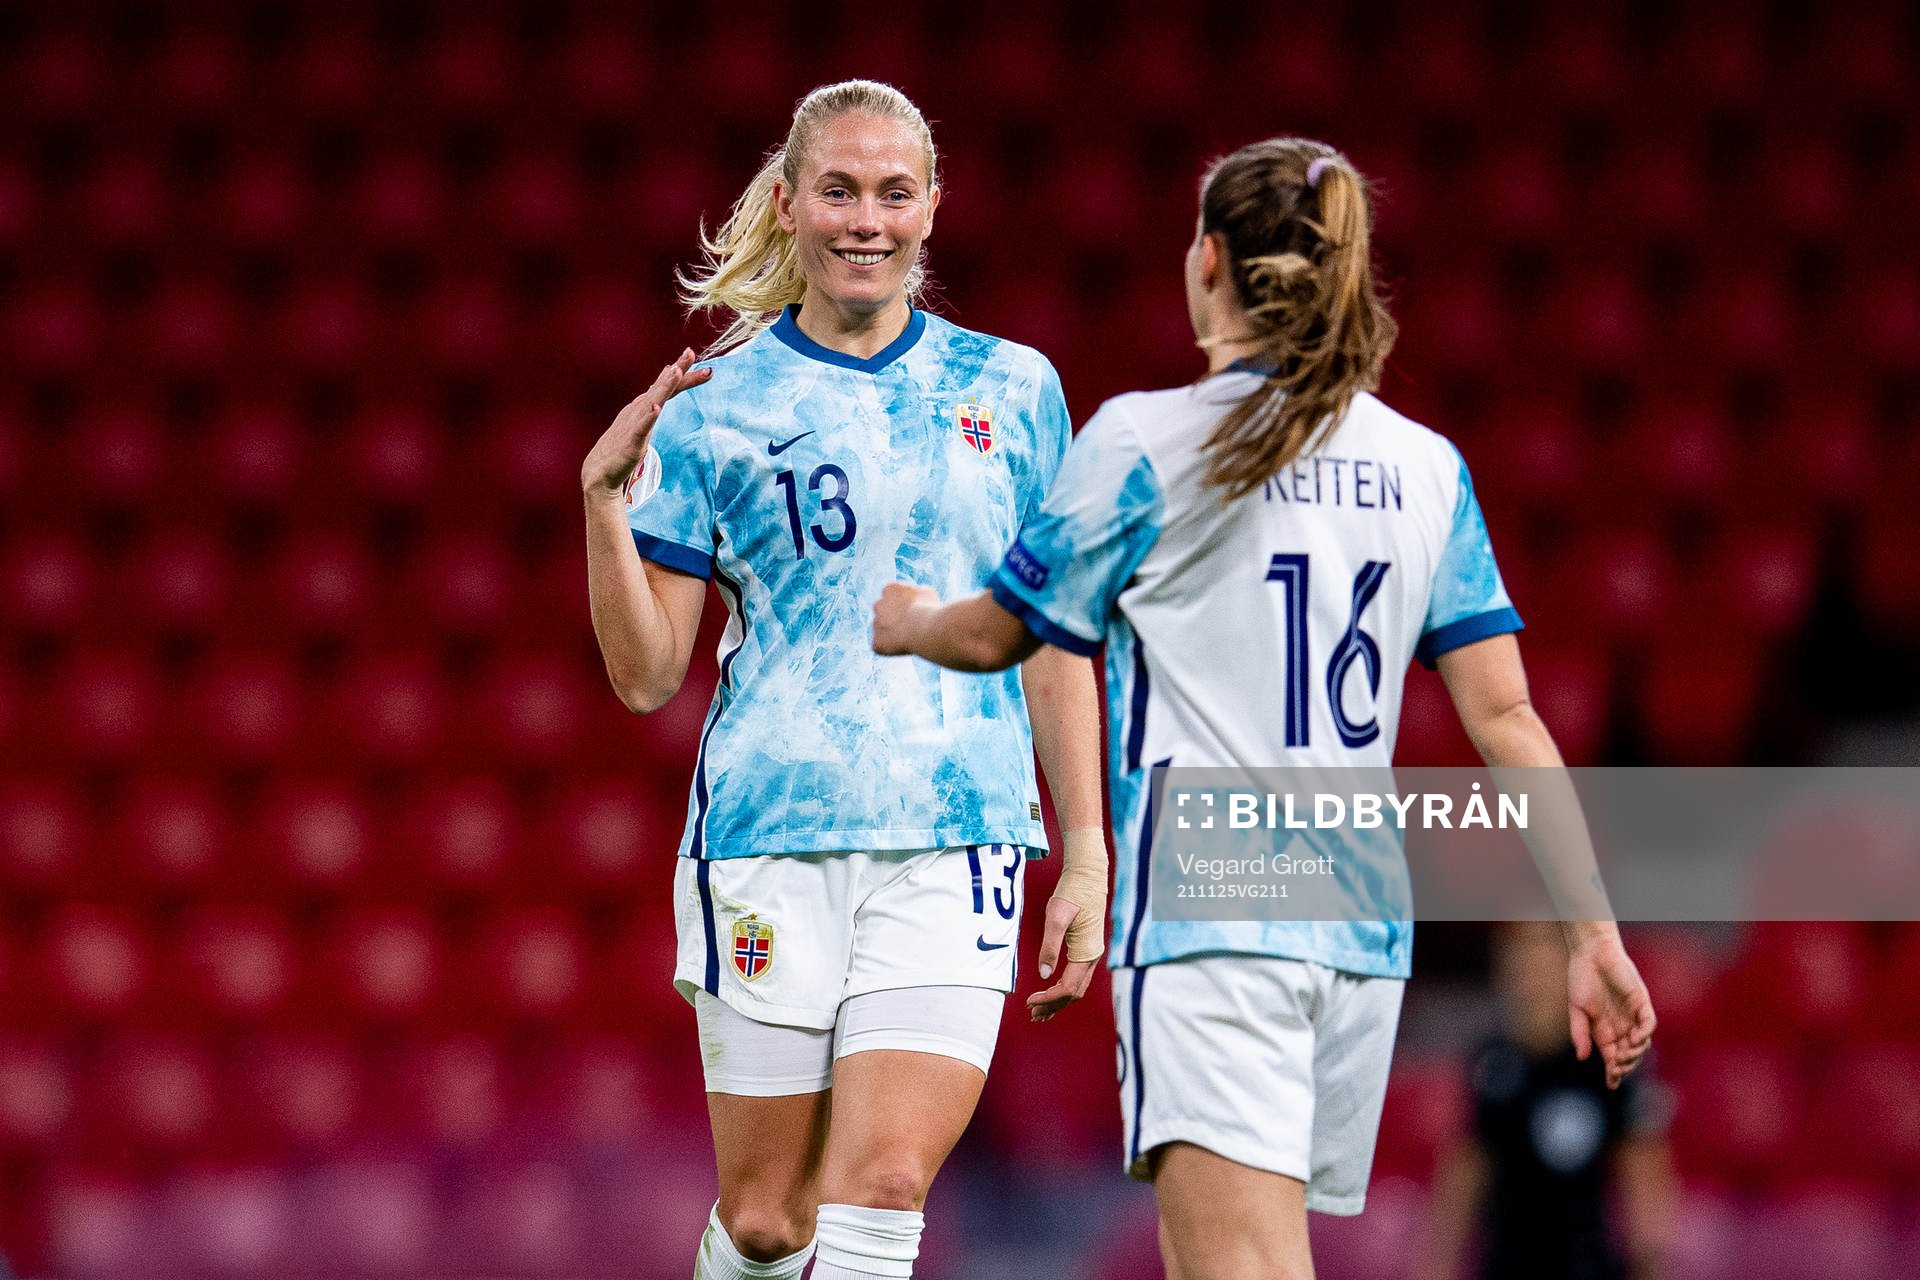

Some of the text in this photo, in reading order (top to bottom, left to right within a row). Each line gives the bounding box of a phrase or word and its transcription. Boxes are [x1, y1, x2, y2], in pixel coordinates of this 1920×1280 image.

[776, 464, 857, 560] 13
[1265, 554, 1391, 748] 16
[966, 844, 1021, 920] 13
